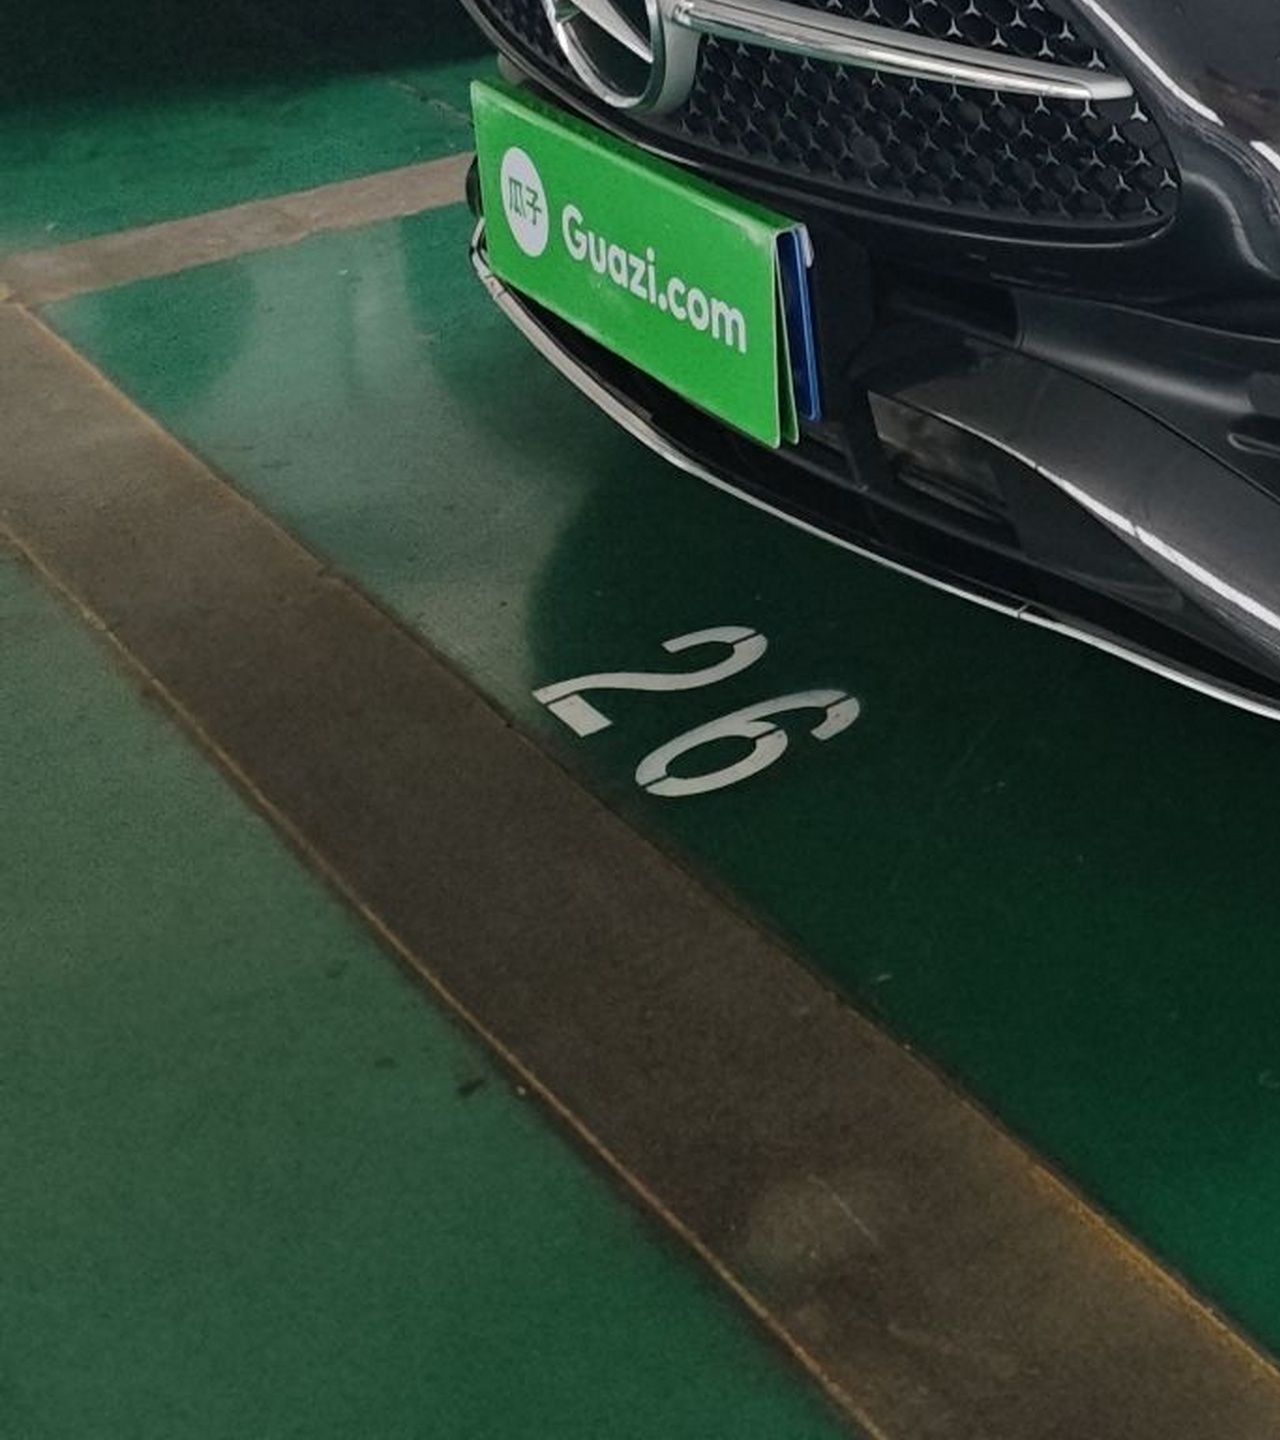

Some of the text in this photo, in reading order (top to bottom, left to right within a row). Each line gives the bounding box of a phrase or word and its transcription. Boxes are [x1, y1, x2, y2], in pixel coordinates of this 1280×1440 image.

[508, 176, 543, 226] 瓜子
[562, 204, 746, 354] Guazi.com
[532, 625, 861, 797] 26
